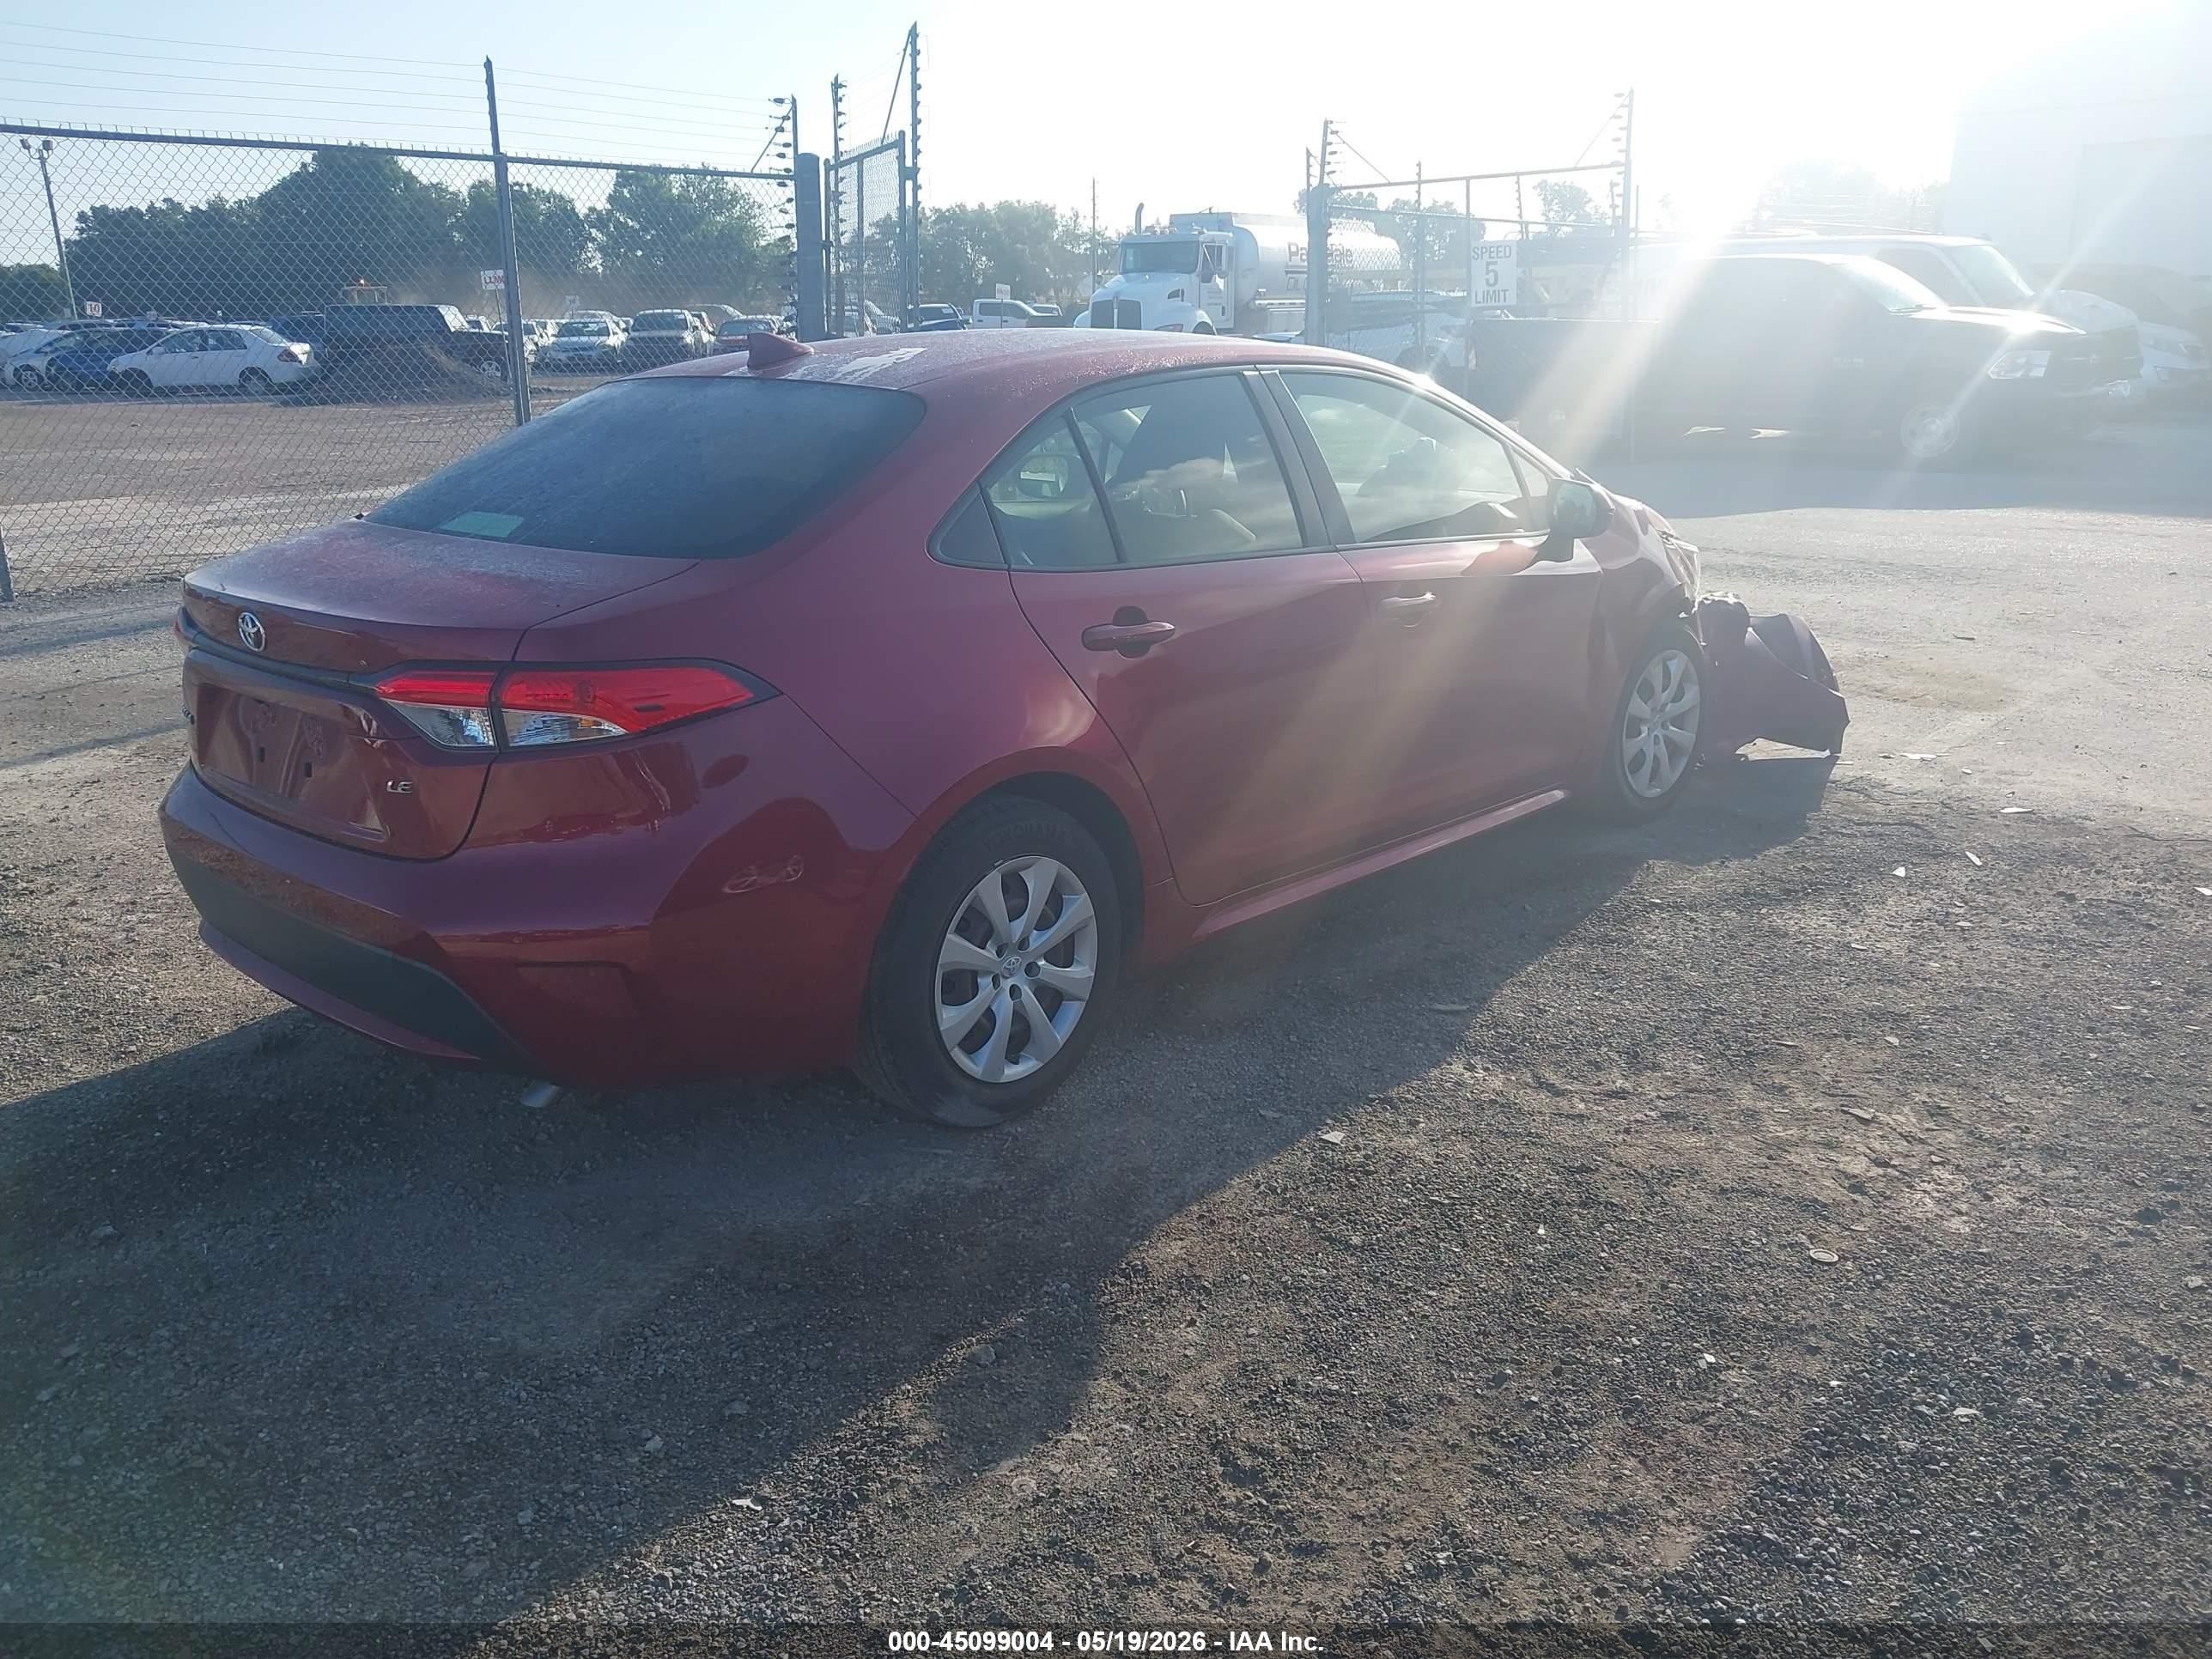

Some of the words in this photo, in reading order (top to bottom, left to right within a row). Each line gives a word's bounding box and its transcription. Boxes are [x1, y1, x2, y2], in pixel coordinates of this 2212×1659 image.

[1472, 245, 1511, 260] SPEED
[1485, 261, 1498, 287] 5
[1474, 289, 1509, 304] LIMIT
[386, 780, 413, 793] LE
